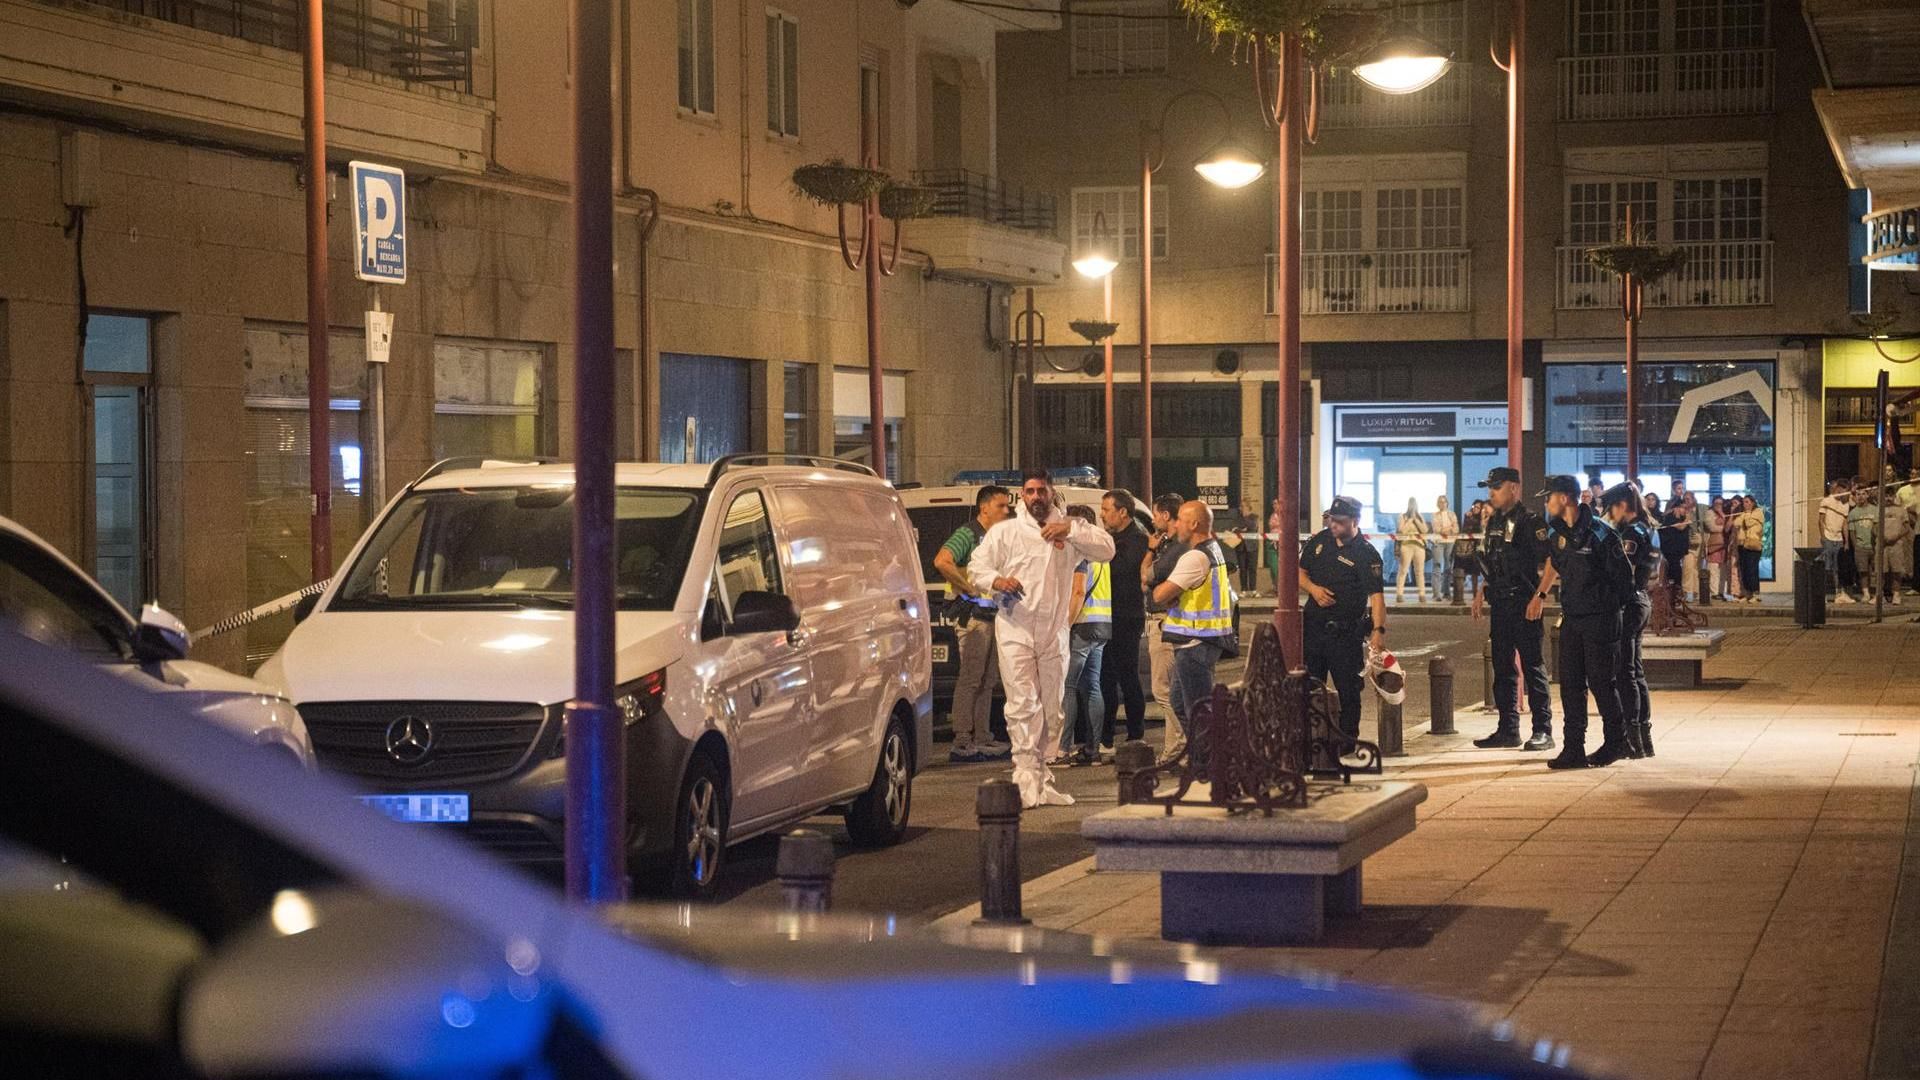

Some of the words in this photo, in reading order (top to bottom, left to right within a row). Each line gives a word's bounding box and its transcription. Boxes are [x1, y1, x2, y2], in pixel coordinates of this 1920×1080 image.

[365, 176, 396, 267] P
[1464, 416, 1508, 426] RITUAL
[1199, 487, 1226, 495] VENDE
